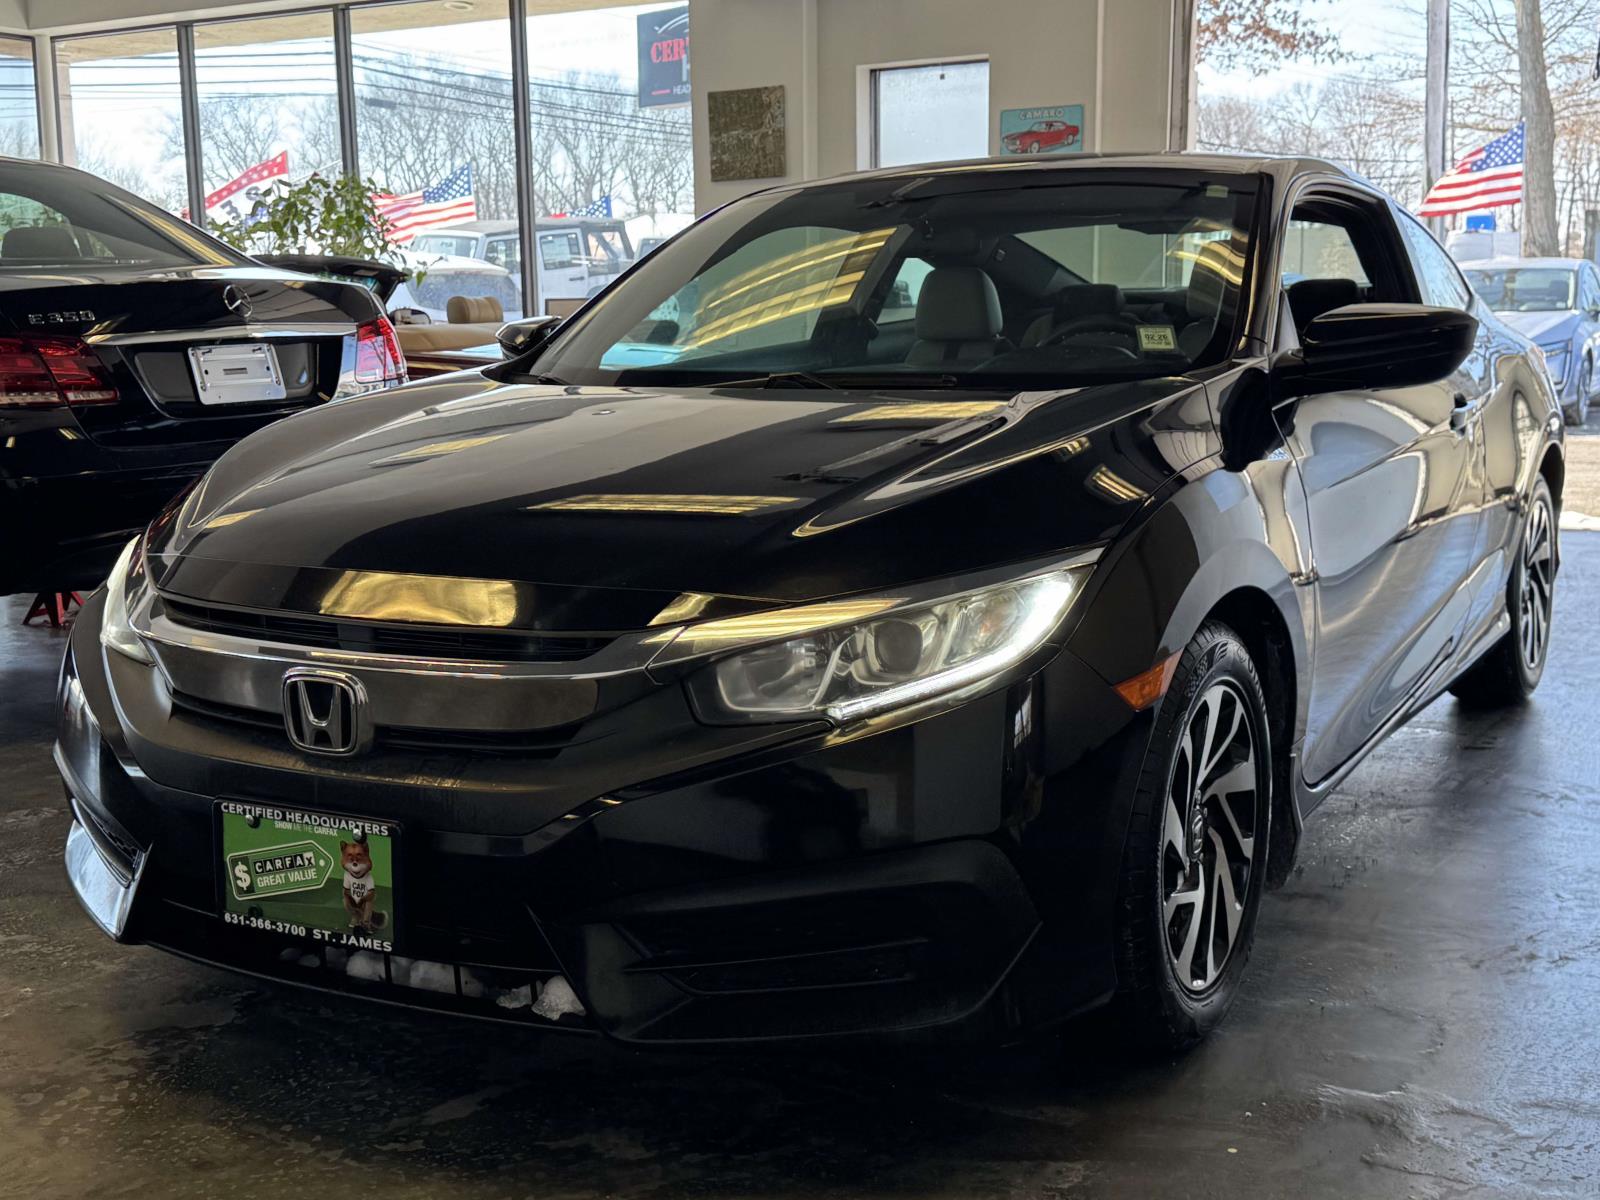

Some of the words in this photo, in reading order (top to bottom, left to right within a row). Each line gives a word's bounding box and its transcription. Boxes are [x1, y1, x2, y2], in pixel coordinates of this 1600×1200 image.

[1020, 108, 1064, 120] CAMARO
[221, 802, 282, 820] CERTIFIED
[286, 811, 389, 837] HEADQUARTERS
[275, 820, 292, 831] SHOW
[314, 825, 338, 837] CARFAX
[255, 855, 313, 874] CARFAX
[257, 873, 286, 888] GREAT
[287, 868, 318, 883] VALUE
[352, 881, 366, 892] CAR
[224, 912, 306, 937] 631-366-3700
[312, 928, 336, 943] ST.
[340, 934, 392, 953] JAMES
